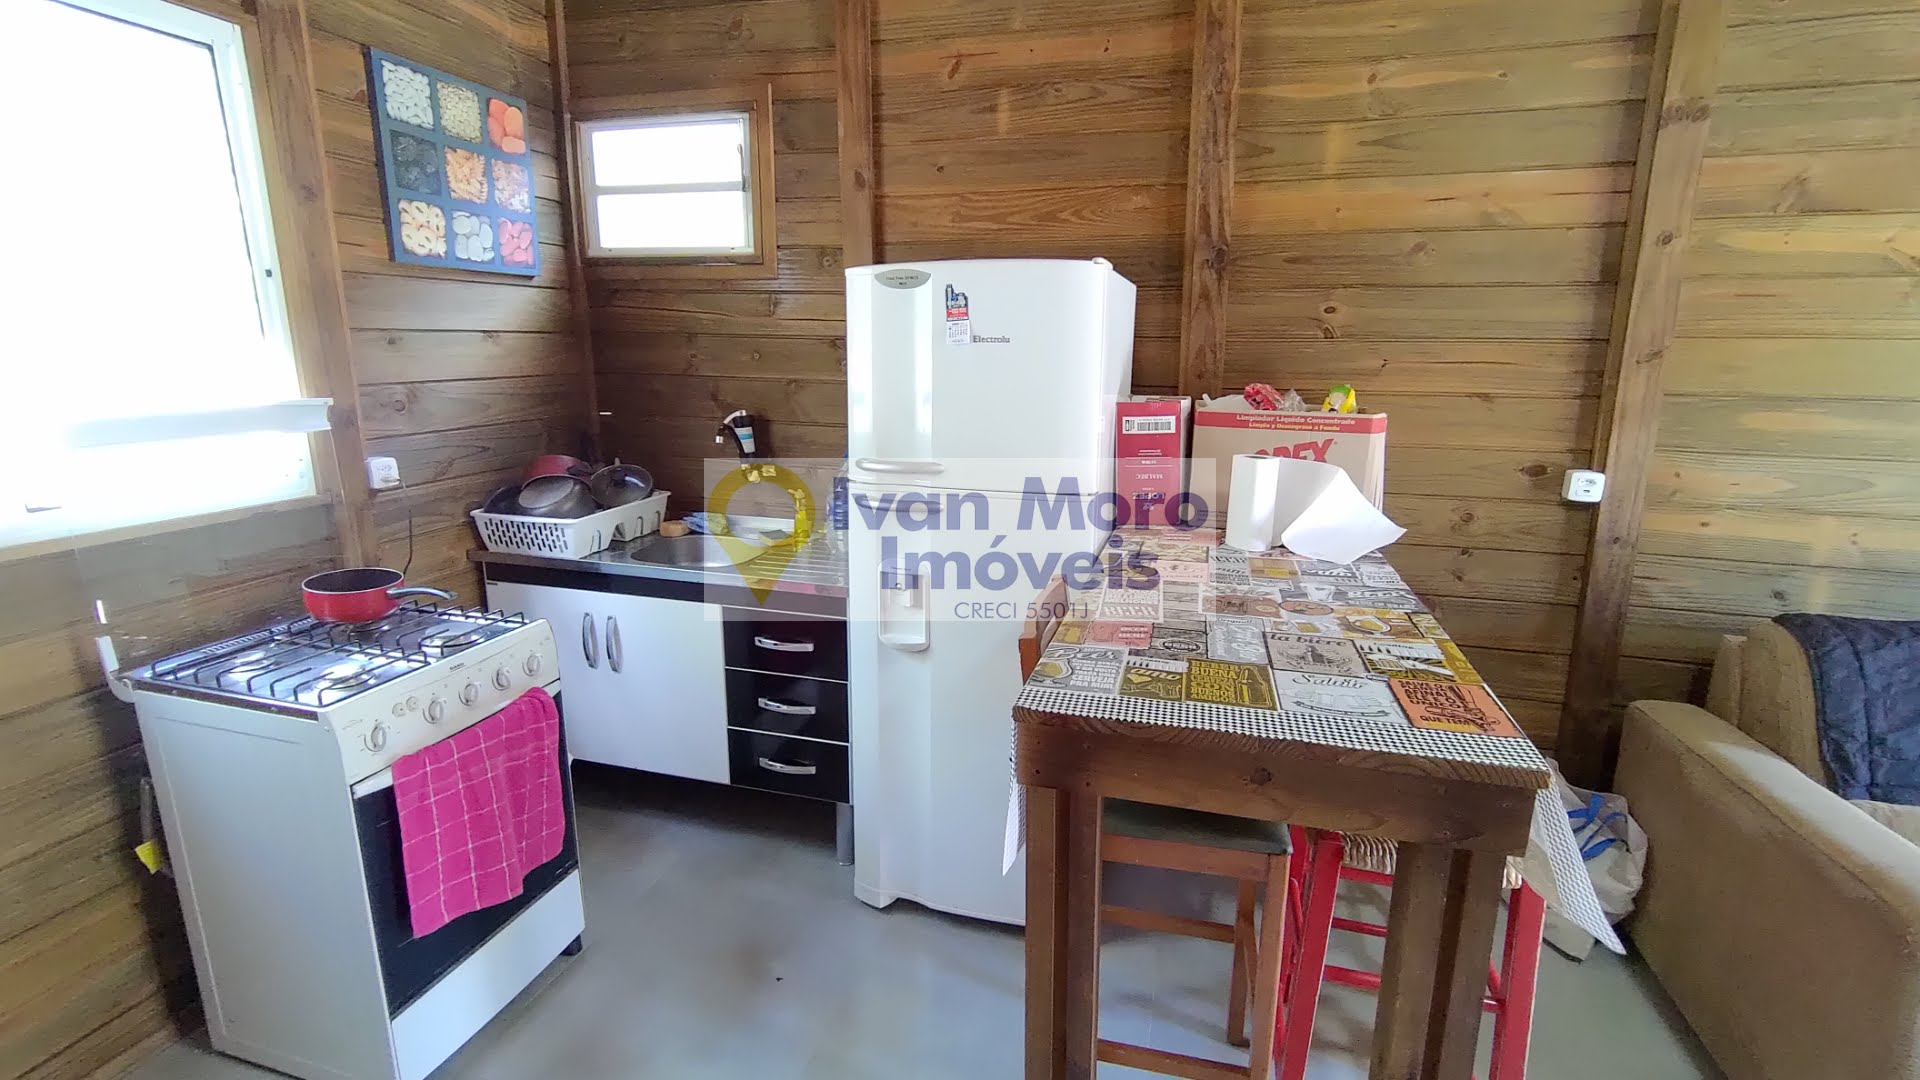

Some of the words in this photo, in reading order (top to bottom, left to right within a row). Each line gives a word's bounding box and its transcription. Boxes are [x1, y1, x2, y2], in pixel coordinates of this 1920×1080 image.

[1190, 667, 1238, 679] BUENA
[1071, 674, 1115, 684] CERVEJA
[1190, 675, 1235, 686] CERVEZA
[1090, 681, 1114, 689] MIM
[1190, 681, 1235, 692] CON
[1190, 687, 1235, 698] BUENOS
[1404, 688, 1449, 698] AFINAL
[1419, 715, 1443, 723] QUE
[1445, 718, 1471, 726] TEM
